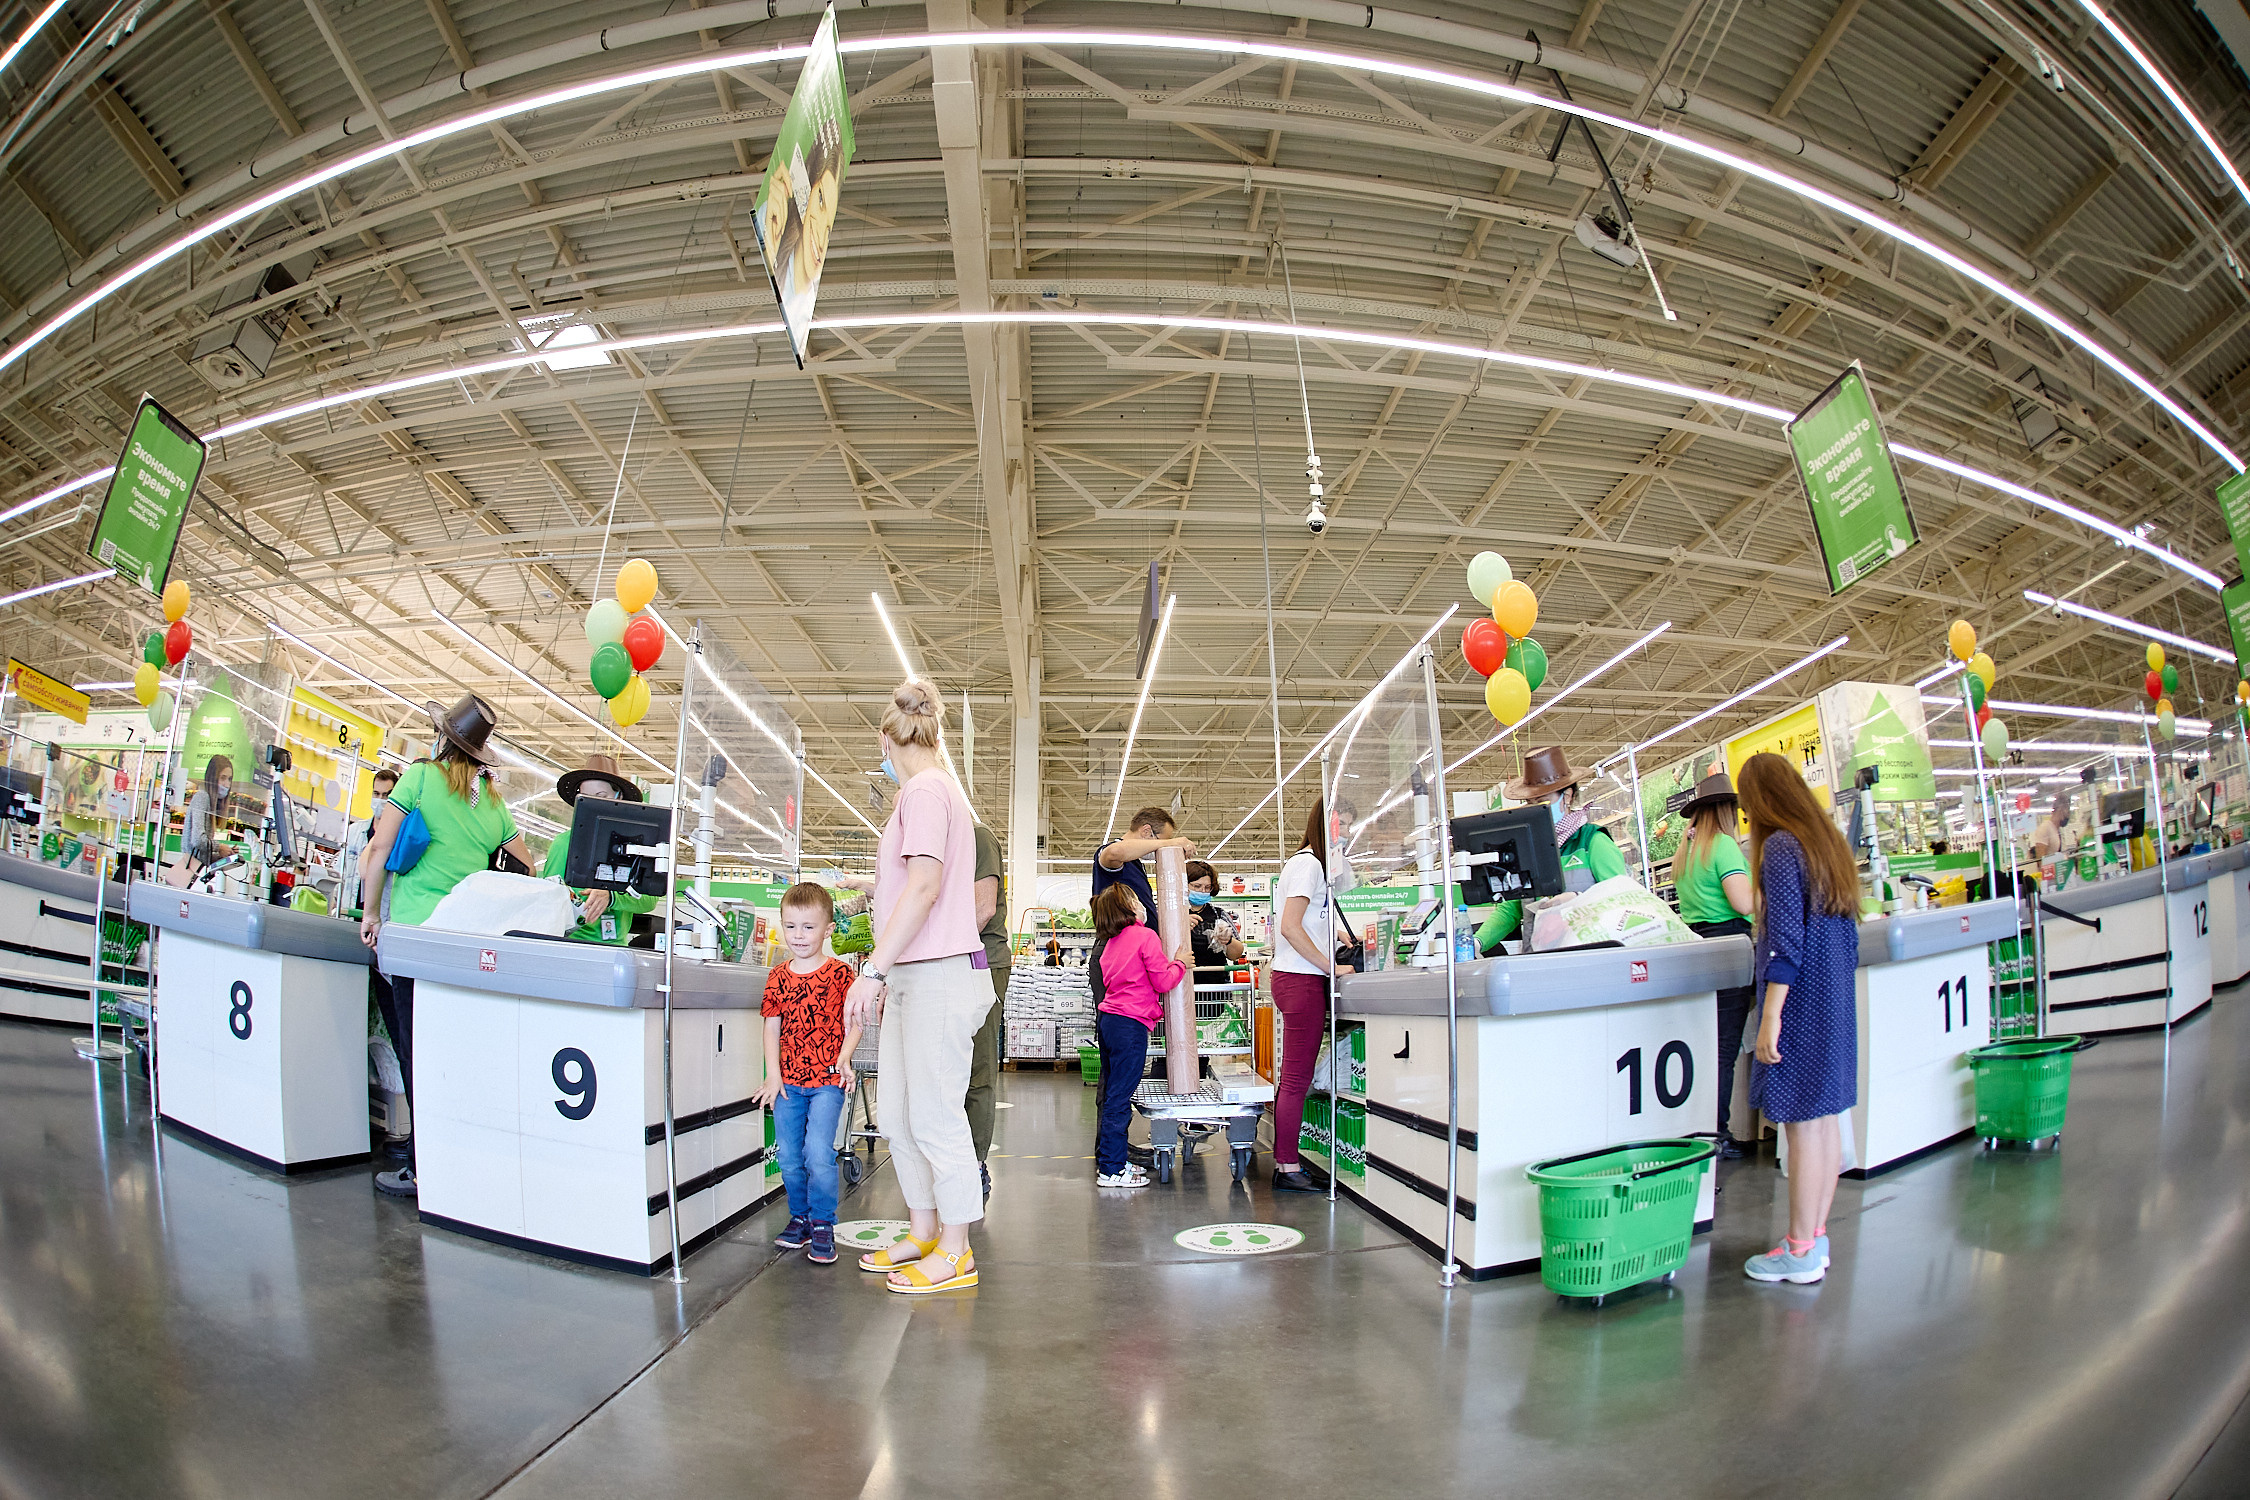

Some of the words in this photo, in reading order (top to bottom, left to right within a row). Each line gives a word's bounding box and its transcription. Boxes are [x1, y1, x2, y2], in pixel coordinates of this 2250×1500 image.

[1807, 418, 1871, 476] Экономьте
[1825, 447, 1863, 484] время
[131, 441, 187, 492] Экономьте
[137, 468, 171, 500] время
[25, 668, 43, 685] Касса
[22, 679, 84, 714] самообслуживания
[127, 726, 135, 743] 7
[338, 724, 348, 744] 8
[1799, 736, 1821, 751] цена
[2010, 748, 2024, 765] 12
[2193, 900, 2208, 938] 12
[229, 980, 253, 1041] 8
[1937, 974, 1968, 1034] 11
[551, 1047, 598, 1121] 9
[1616, 1040, 1694, 1116] 10
